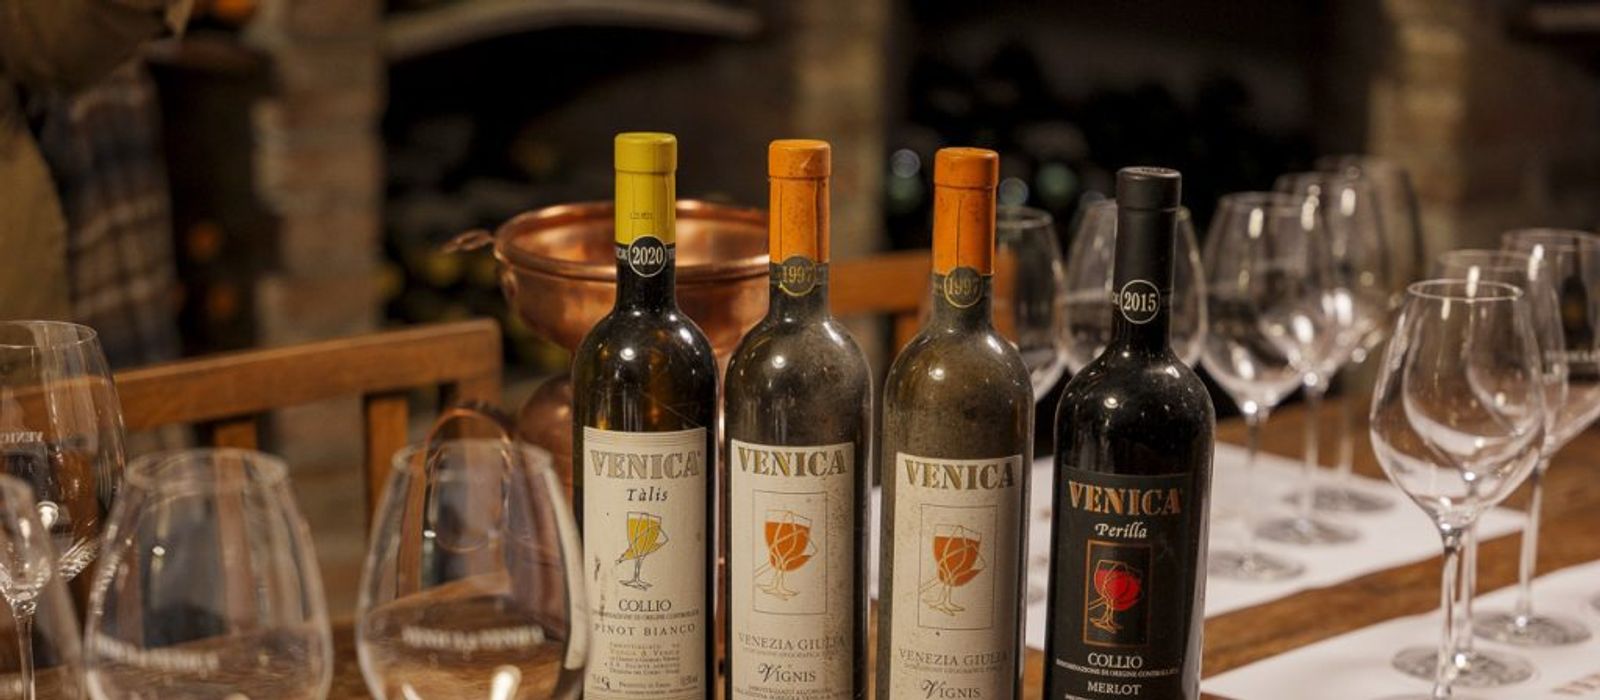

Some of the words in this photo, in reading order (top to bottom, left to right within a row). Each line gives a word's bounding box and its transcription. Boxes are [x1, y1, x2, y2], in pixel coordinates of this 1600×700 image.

[632, 246, 664, 265] 2020
[782, 265, 815, 284] 1997
[949, 277, 979, 296] 1997
[1123, 291, 1157, 312] 2015
[590, 450, 700, 480] VENICA
[737, 447, 847, 477] VENICA
[905, 459, 1014, 490] VENICA
[626, 486, 668, 502] Tàlis
[1068, 480, 1182, 516] VENICA
[1094, 521, 1147, 539] Perilla
[618, 599, 671, 612] COLLIO
[594, 623, 637, 636] PINOT
[644, 623, 696, 636] BIANCO
[738, 633, 794, 651] VENEZIA
[899, 648, 958, 665] VENEZIA
[1087, 652, 1143, 668] COLLIO
[1087, 681, 1142, 695] MERLOT
